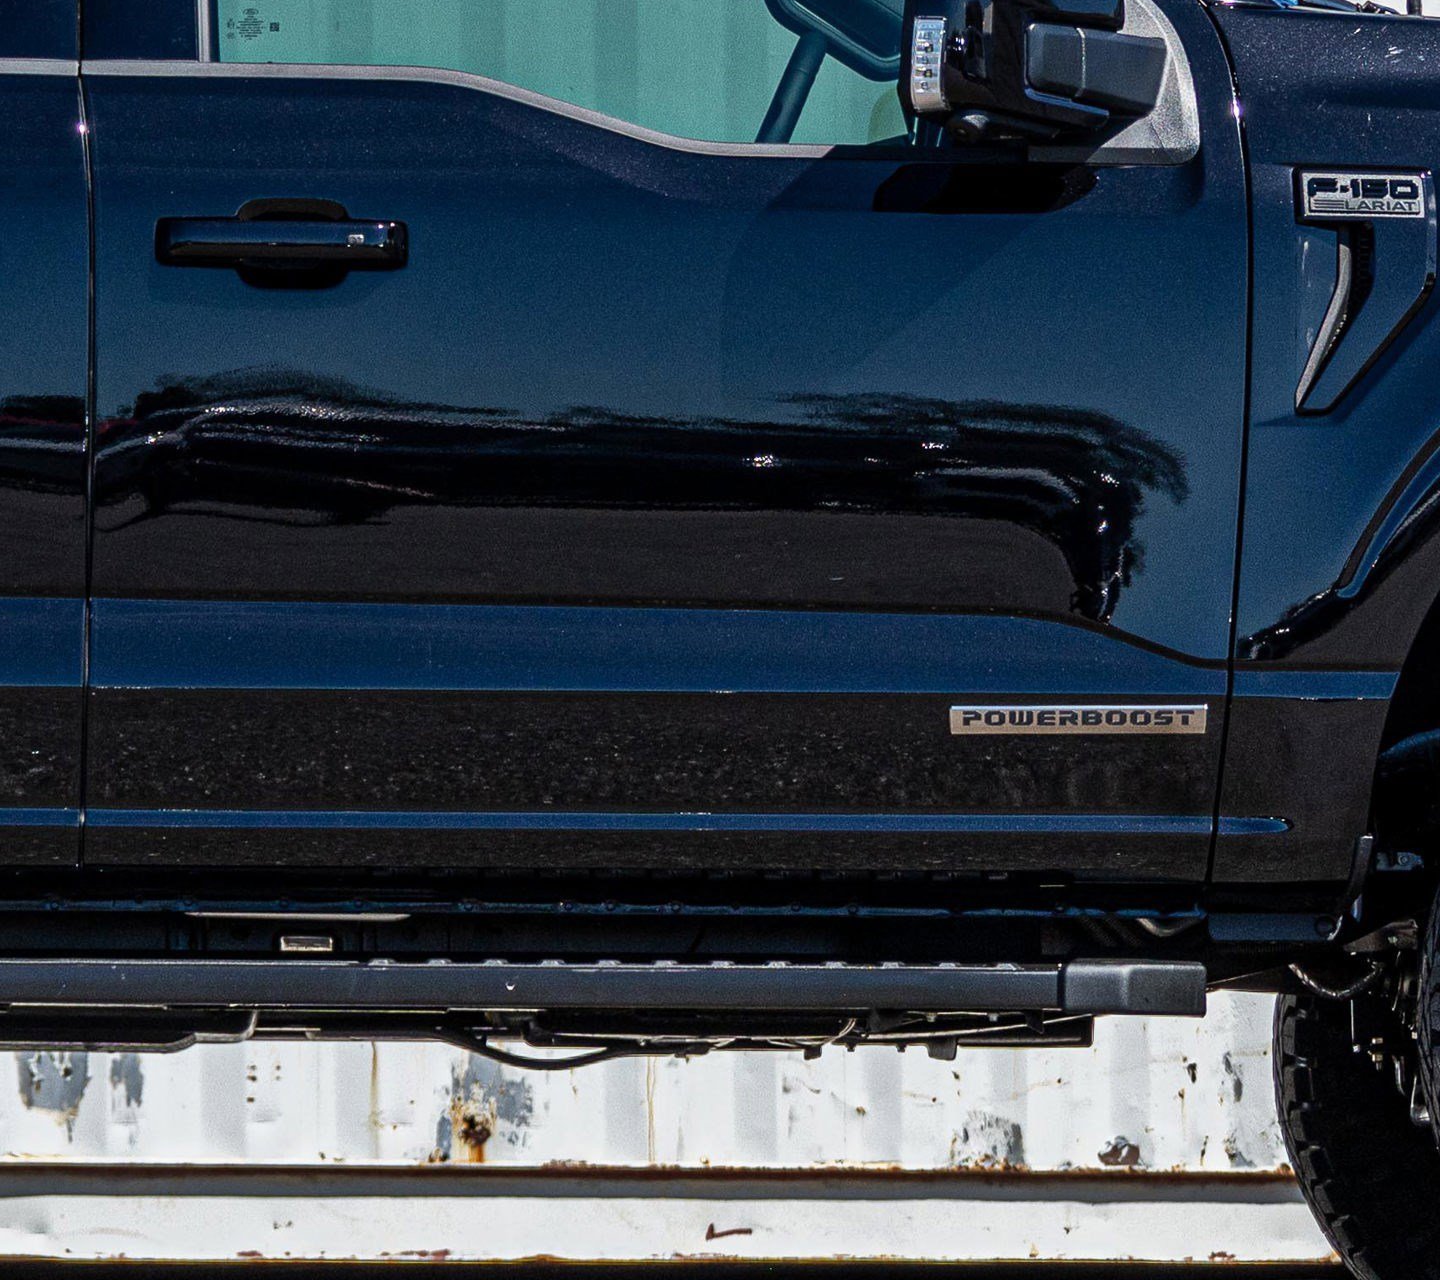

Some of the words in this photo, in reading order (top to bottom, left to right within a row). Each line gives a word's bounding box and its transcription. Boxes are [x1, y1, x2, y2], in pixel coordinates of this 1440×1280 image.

[1307, 177, 1420, 199] F-150
[1345, 200, 1417, 212] LARIAT
[961, 709, 1195, 727] POWERBOOST
